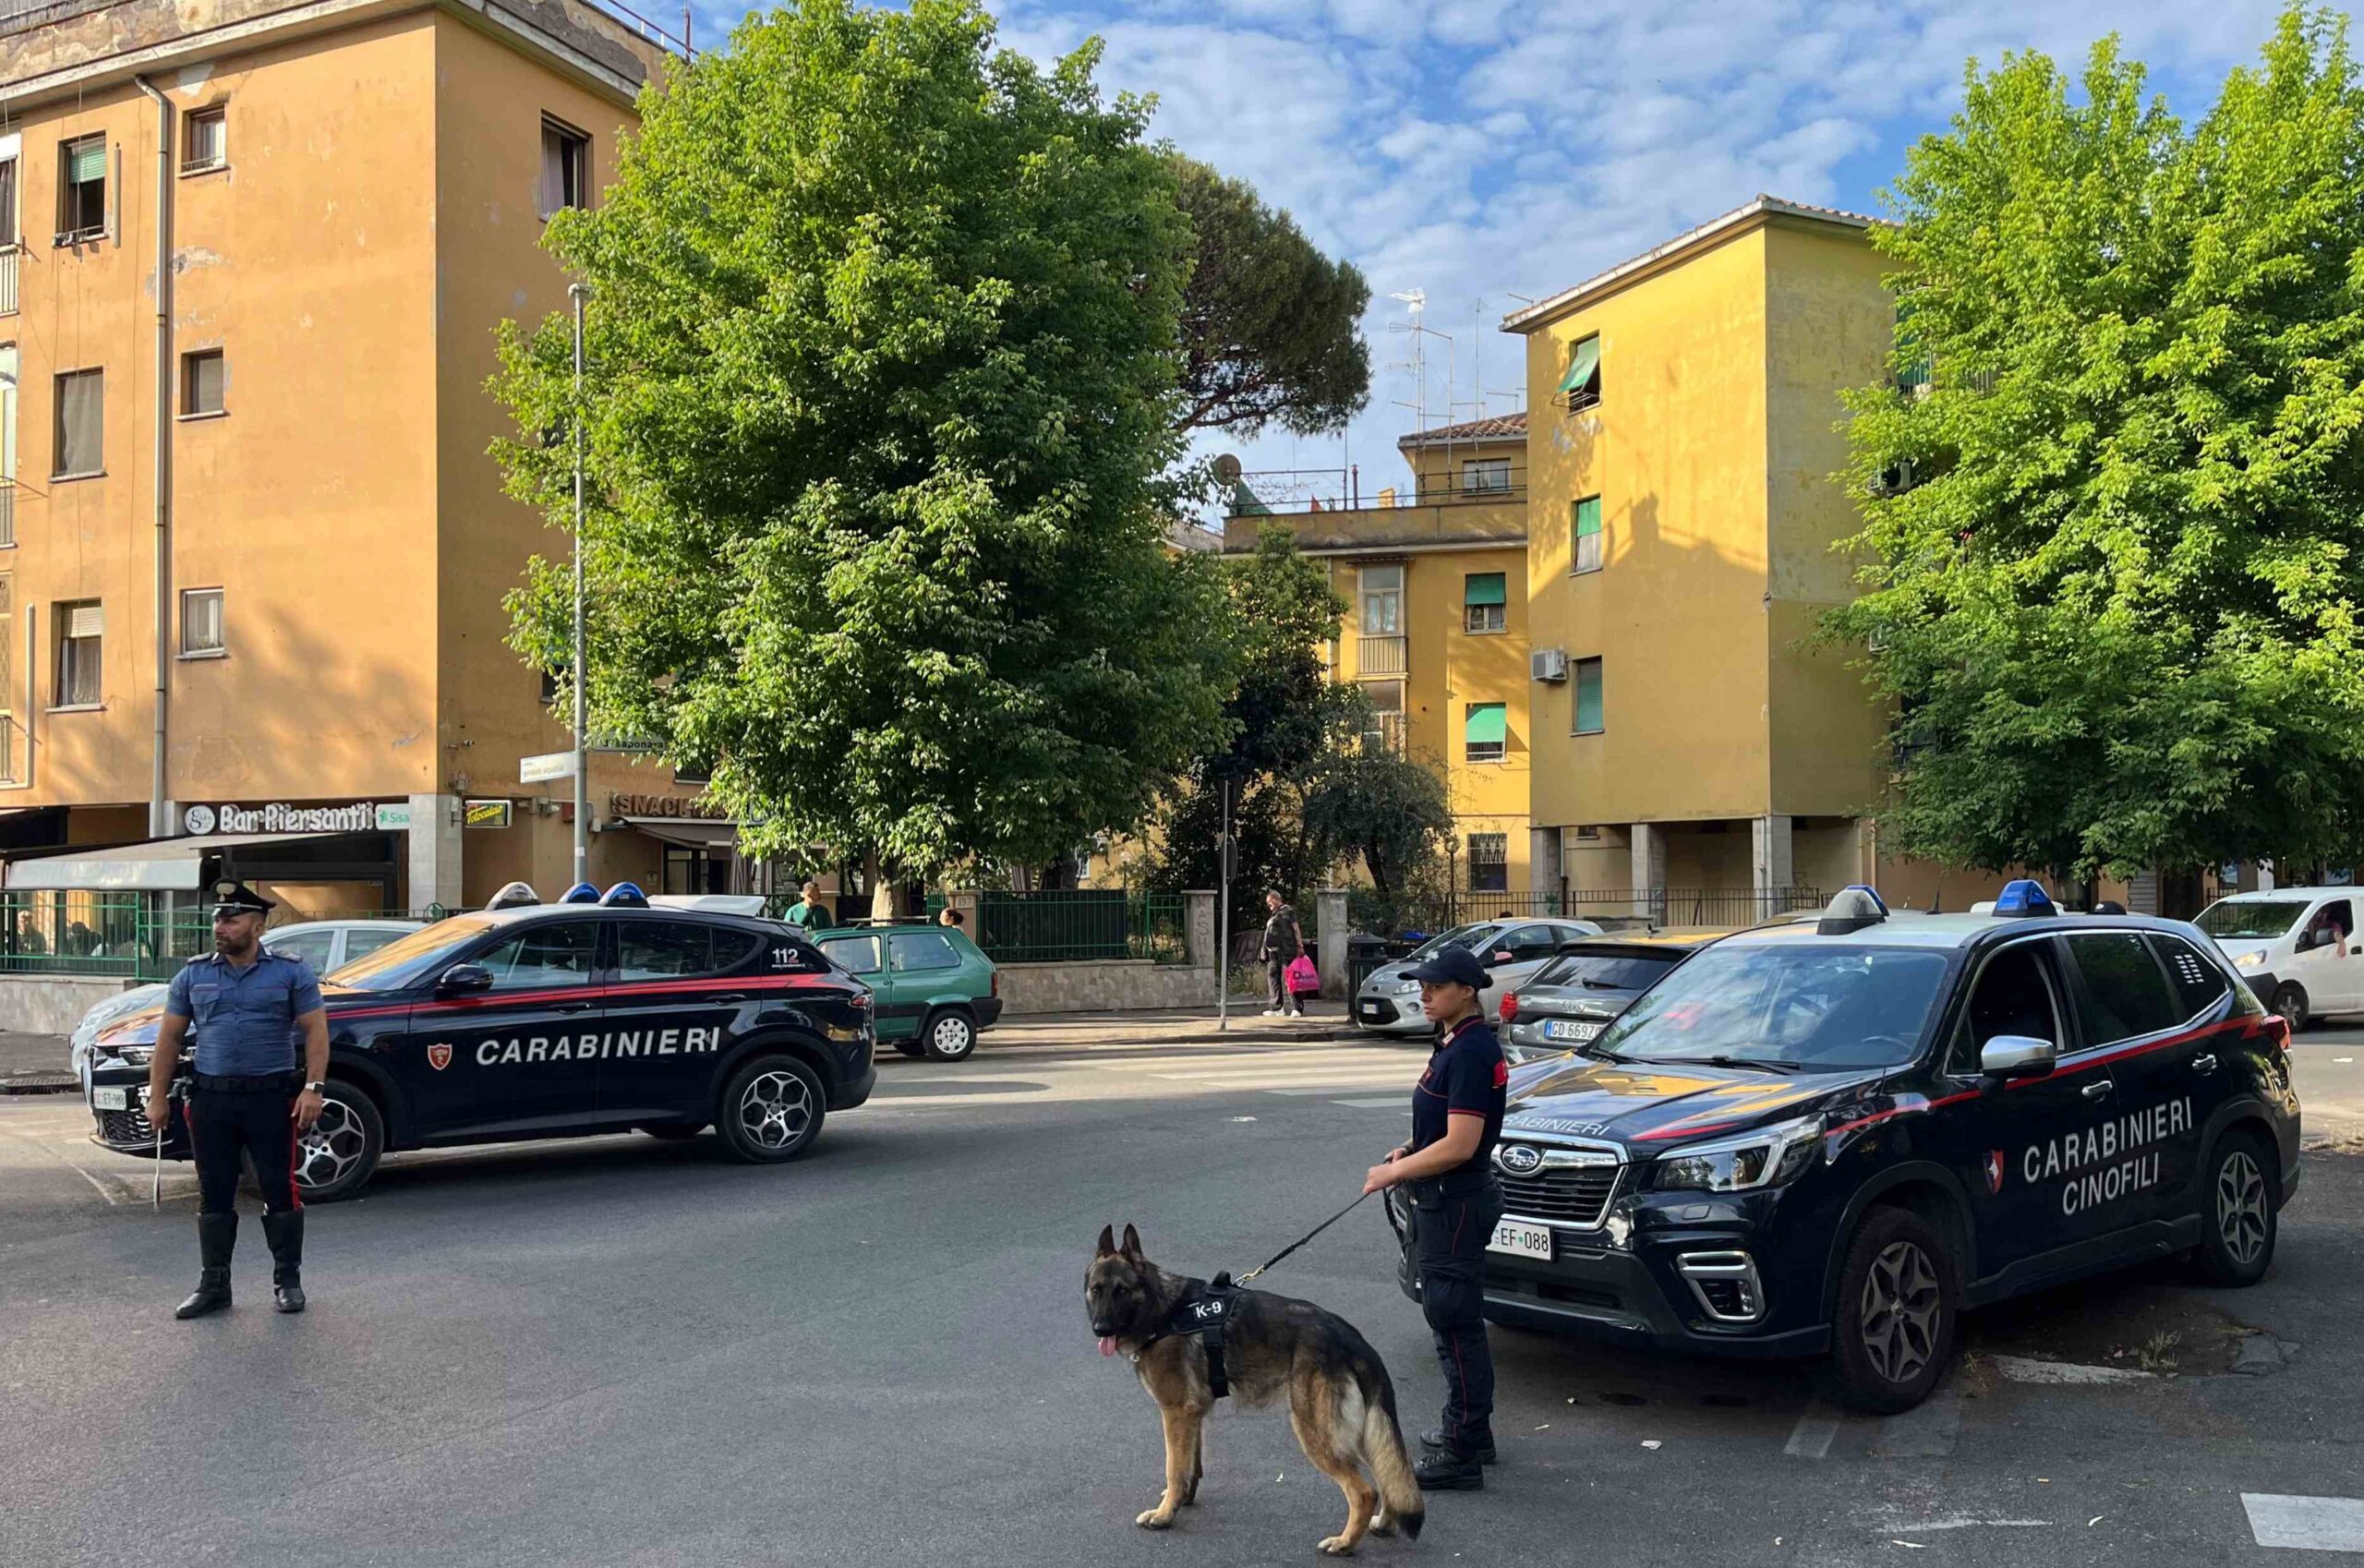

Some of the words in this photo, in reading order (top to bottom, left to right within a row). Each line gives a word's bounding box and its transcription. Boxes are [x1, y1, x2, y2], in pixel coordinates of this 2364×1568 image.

[220, 804, 259, 832] Bar
[265, 802, 372, 831] Piersanti
[772, 947, 799, 963] 112
[476, 1027, 719, 1065] CARABINIERI
[2024, 1096, 2192, 1183] CARABINIERI
[2063, 1152, 2159, 1215] CINOFILI
[1196, 1301, 1222, 1318] K-9
